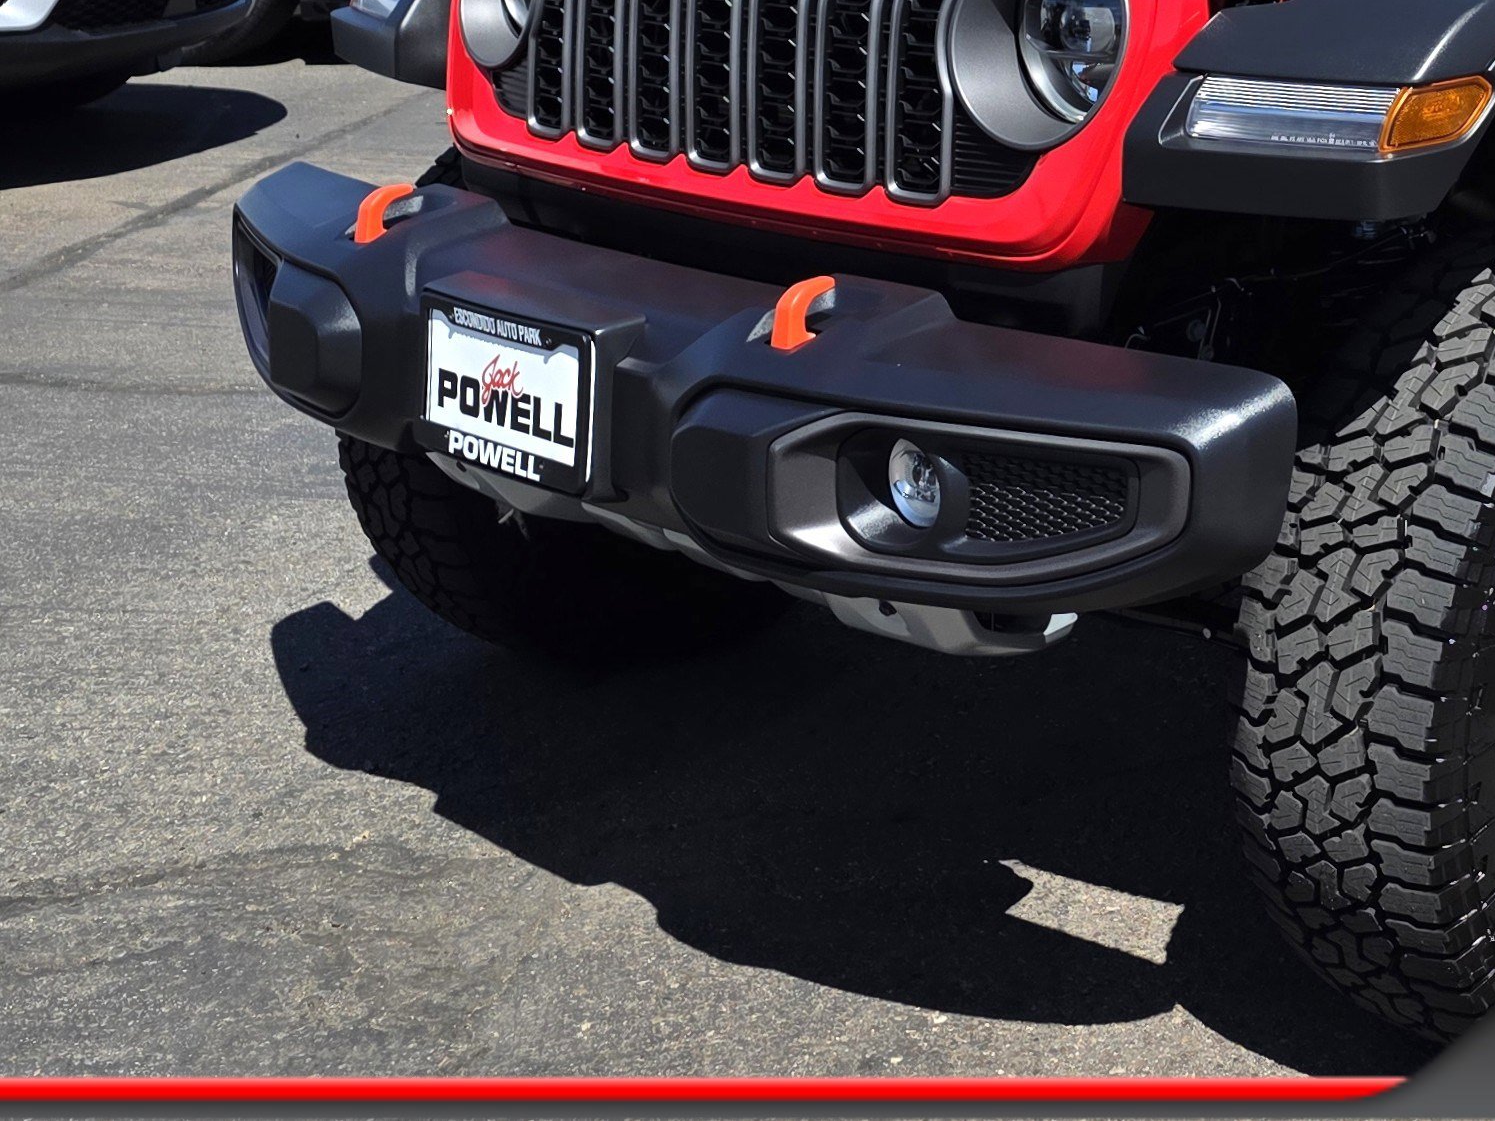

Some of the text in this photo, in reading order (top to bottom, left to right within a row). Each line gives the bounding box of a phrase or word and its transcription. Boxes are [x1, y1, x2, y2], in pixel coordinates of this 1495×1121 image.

[453, 306, 542, 346] ESCONDIDO AUTO PARK
[481, 353, 524, 406] Jack
[438, 367, 575, 449] POWELL
[448, 429, 541, 482] POWELL
